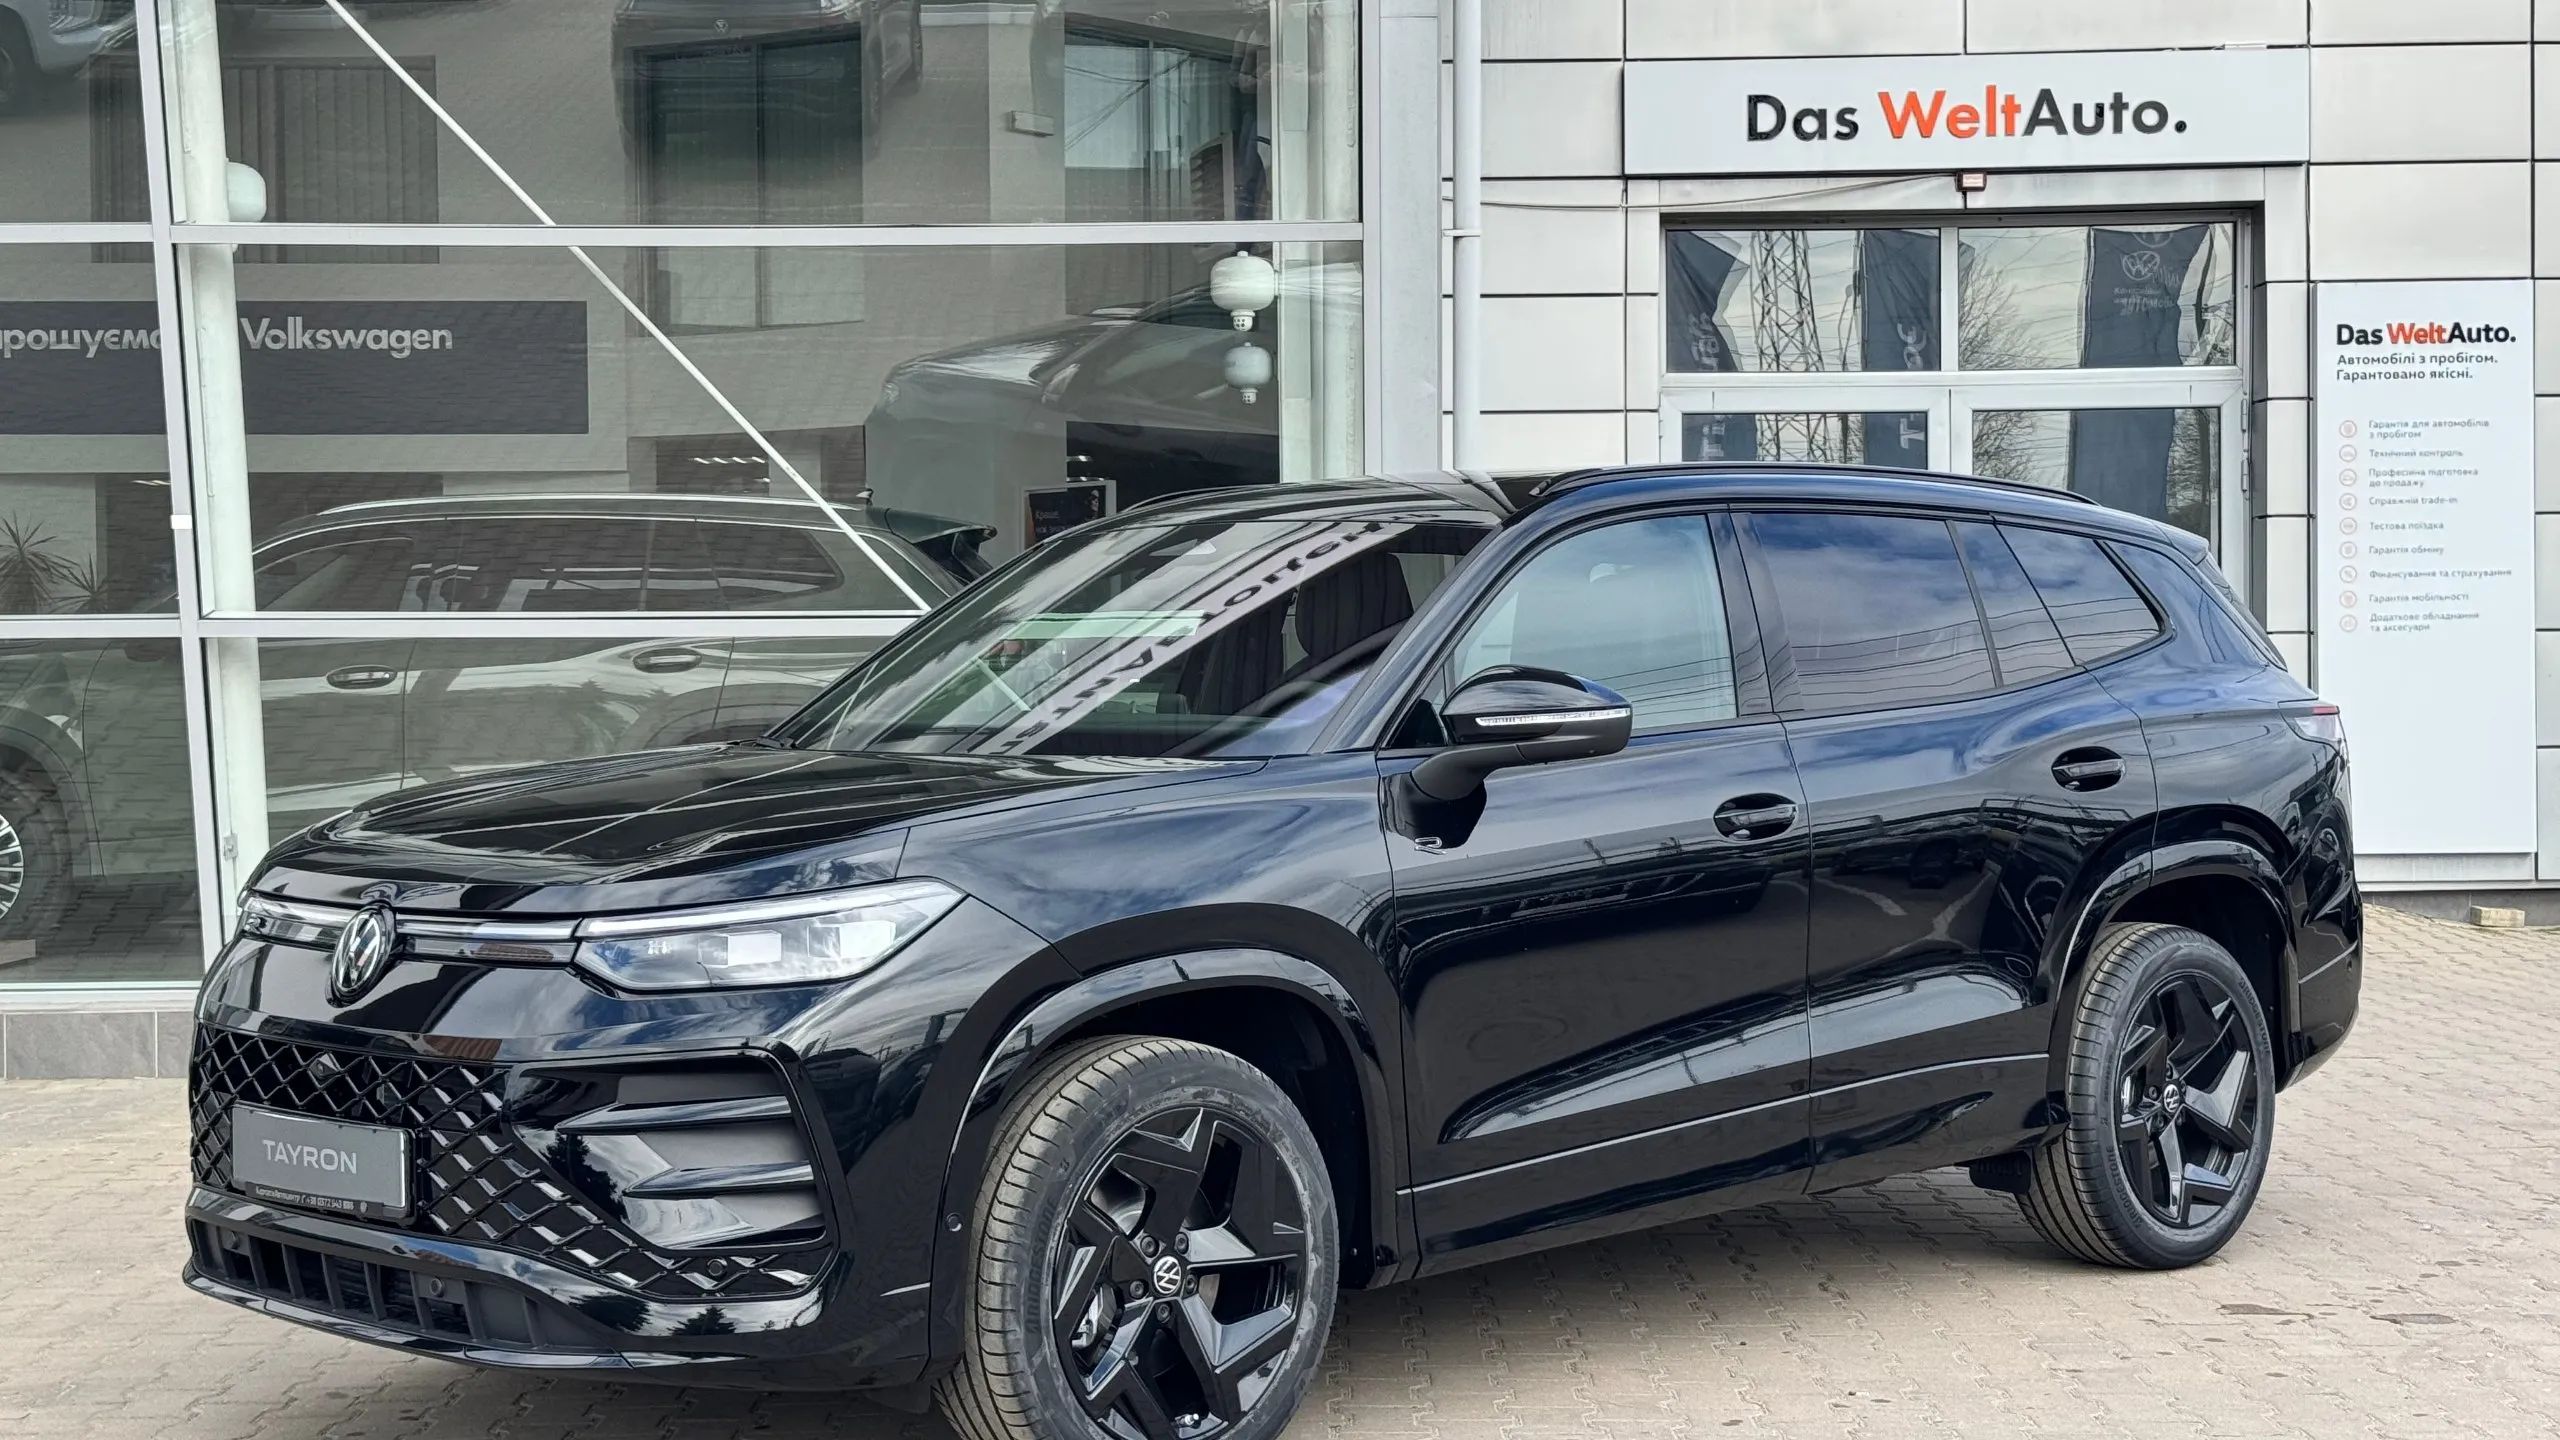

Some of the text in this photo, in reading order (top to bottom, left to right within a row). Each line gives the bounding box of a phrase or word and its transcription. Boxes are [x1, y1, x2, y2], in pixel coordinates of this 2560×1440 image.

[1746, 84, 2188, 141] Das WeltAuto.
[0, 328, 162, 359] рошуєм
[241, 317, 453, 358] Volkswagen
[2336, 321, 2517, 345] Das WeltAuto.
[2337, 352, 2498, 366] Автомобілі з пробігом.
[2336, 367, 2473, 383] Гарантовано якісні.
[261, 1139, 357, 1174] TAYRON
